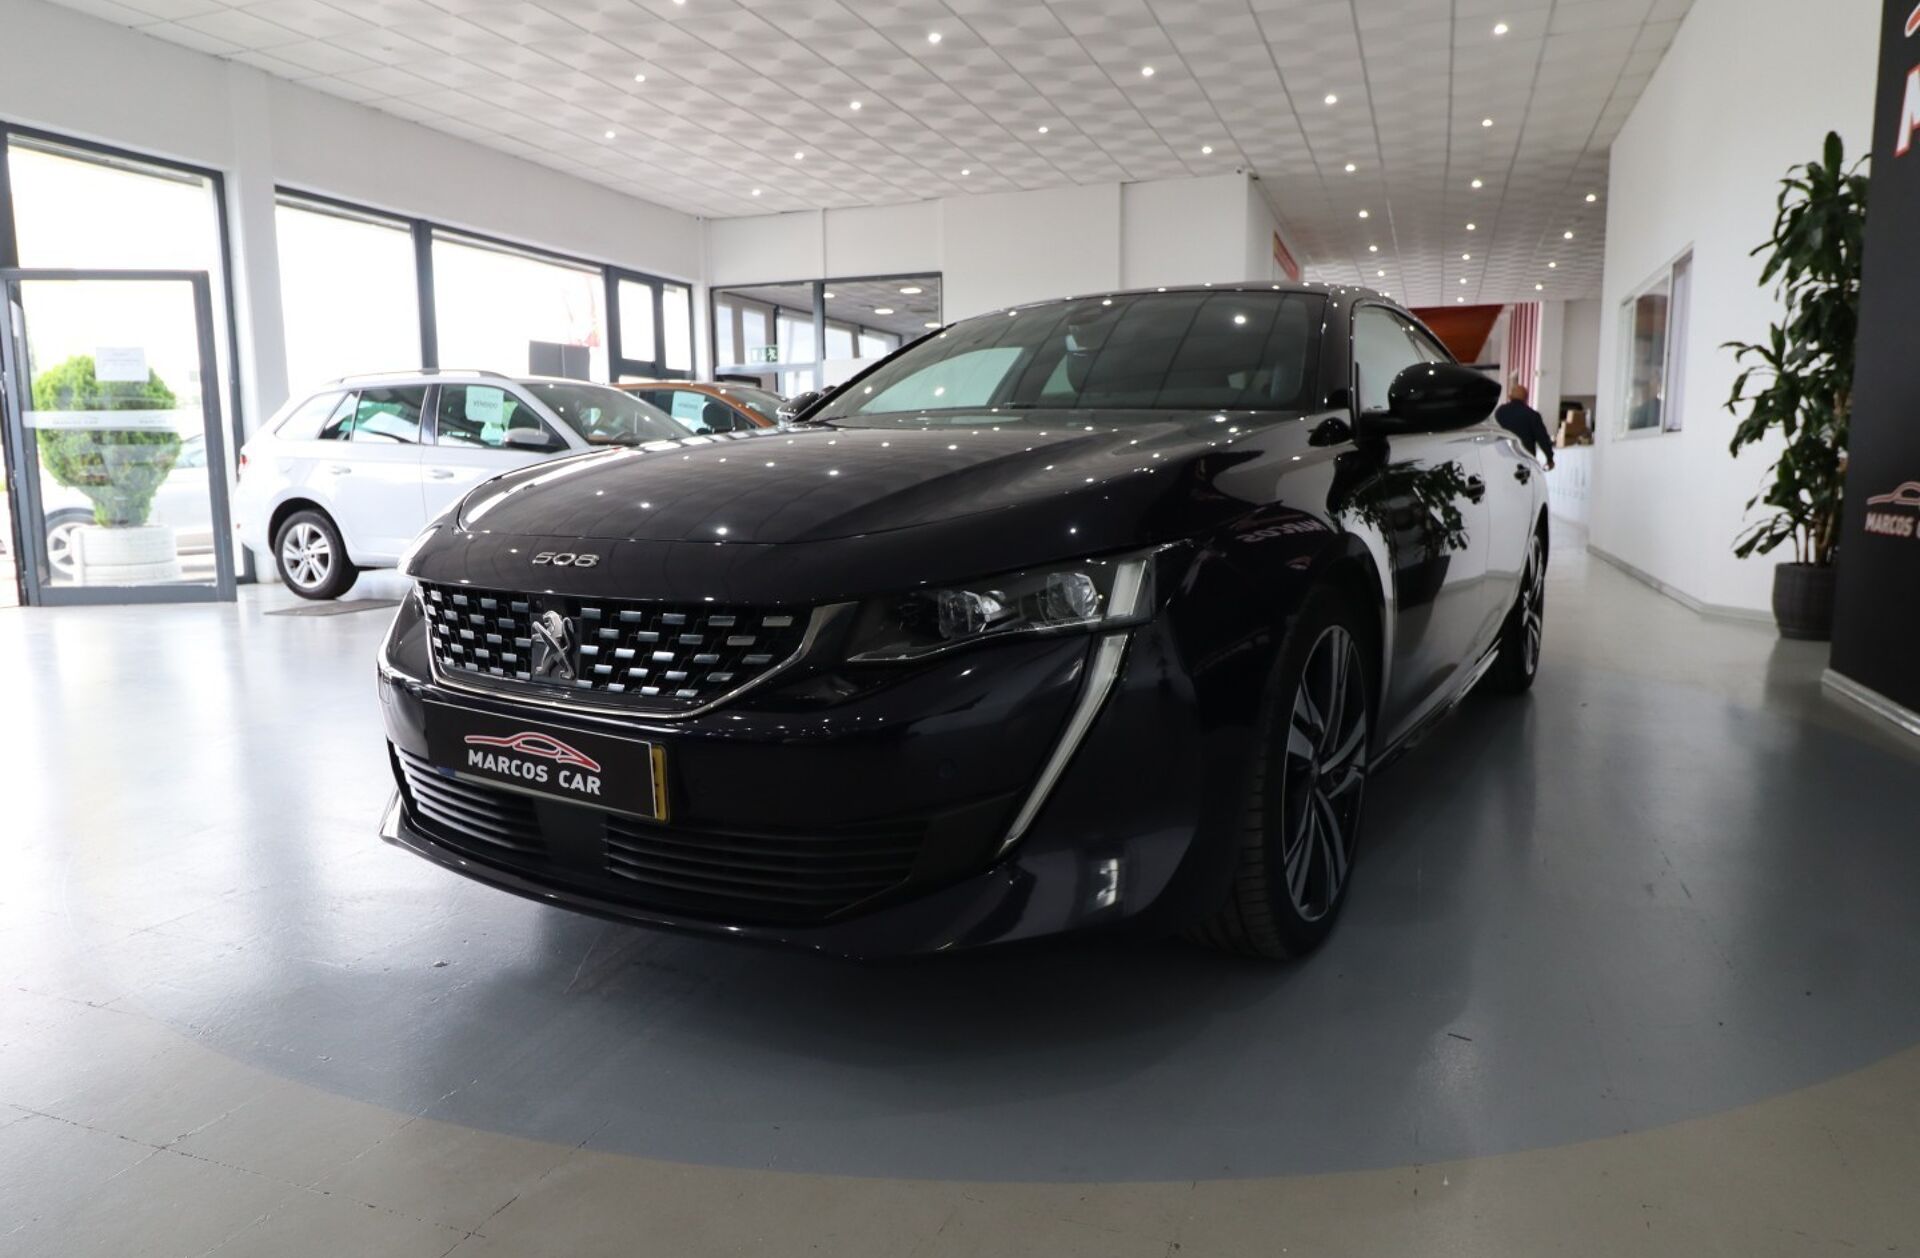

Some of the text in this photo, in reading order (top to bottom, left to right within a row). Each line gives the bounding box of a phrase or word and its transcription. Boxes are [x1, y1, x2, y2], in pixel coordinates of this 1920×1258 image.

[1864, 513, 1914, 537] MARCOS
[532, 551, 599, 567] 508
[468, 749, 601, 795] MARCOS CAR
